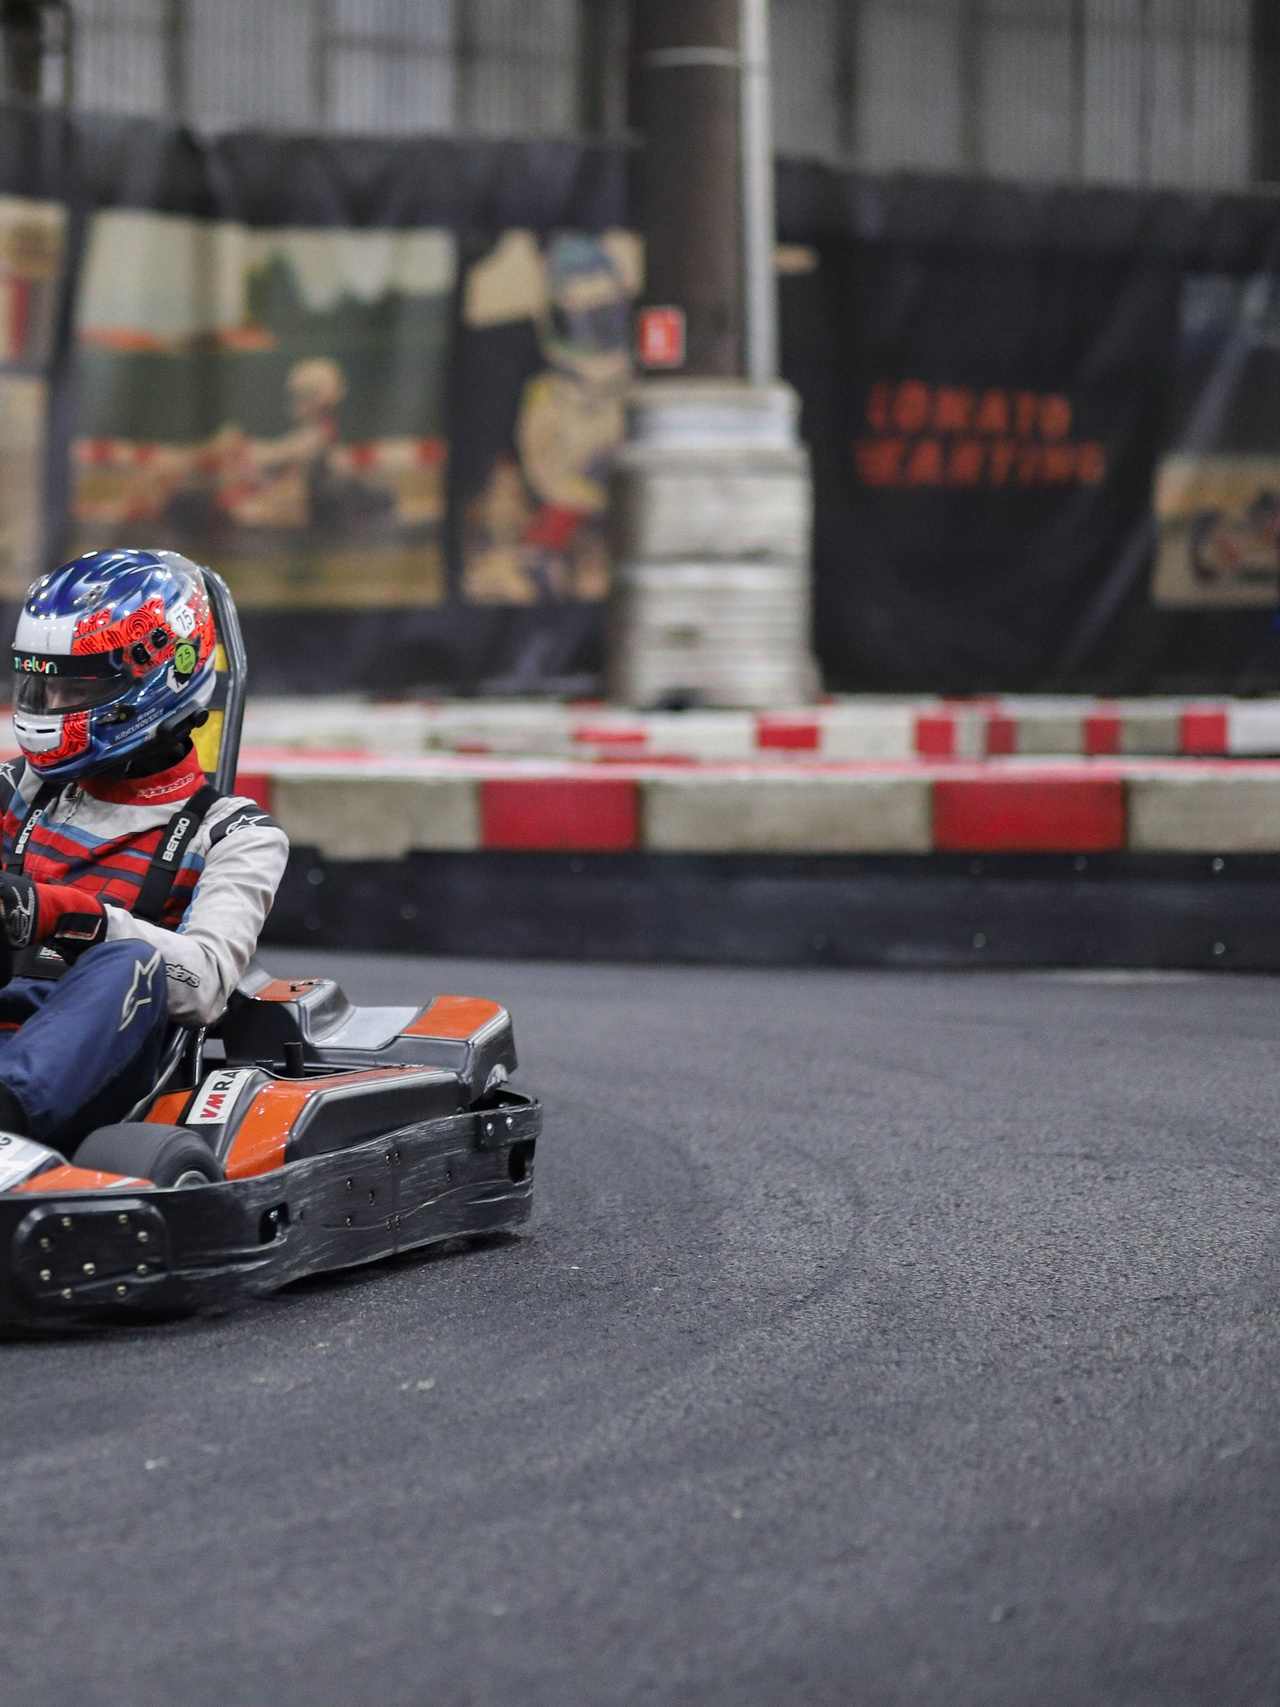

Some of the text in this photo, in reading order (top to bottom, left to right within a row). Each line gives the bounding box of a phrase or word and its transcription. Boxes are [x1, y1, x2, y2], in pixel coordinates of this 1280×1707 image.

[867, 379, 1073, 438] LONATO
[14, 808, 43, 855] BENGIO
[161, 817, 191, 862] BENGIO
